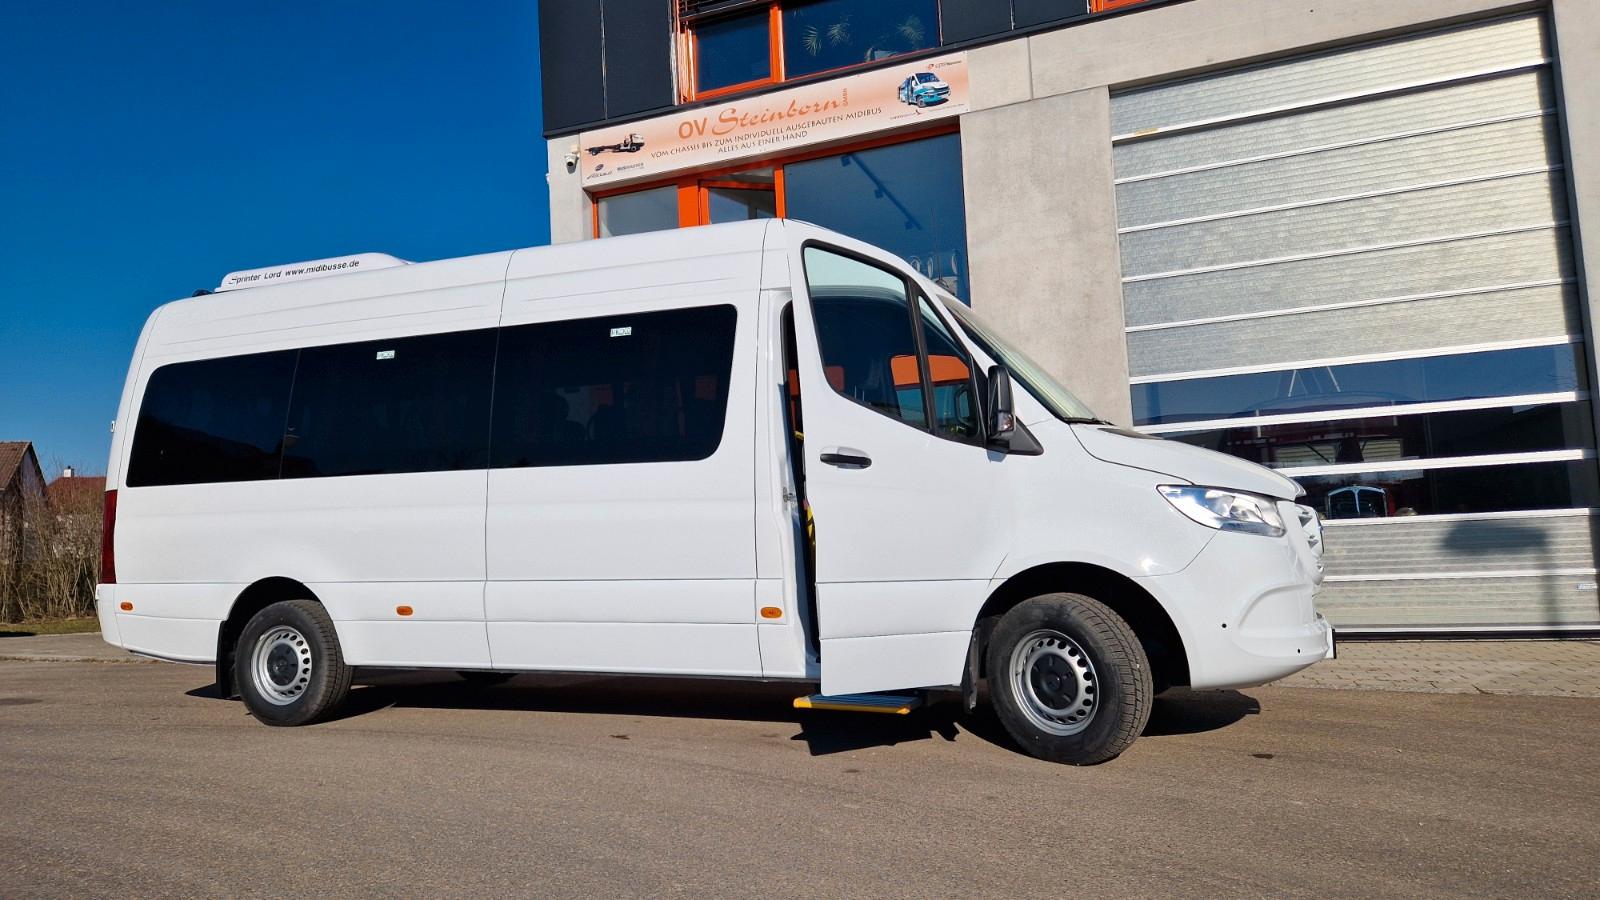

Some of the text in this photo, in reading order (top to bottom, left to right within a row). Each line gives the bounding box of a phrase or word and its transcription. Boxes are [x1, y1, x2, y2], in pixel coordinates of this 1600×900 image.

[651, 150, 669, 159] VOM
[670, 143, 700, 155] CHASSIS
[702, 140, 713, 149] BIS
[714, 138, 733, 147] ZUM
[734, 127, 784, 143] INDIVIDUELL
[786, 114, 843, 133] AUSGEBAUTEN
[845, 106, 882, 120] MIDIBUS
[678, 100, 840, 139] OV Steinborn
[718, 130, 808, 153] ALLES AUS EINER HAND
[264, 270, 282, 280] Lord
[285, 259, 360, 277] www.midibusse.de
